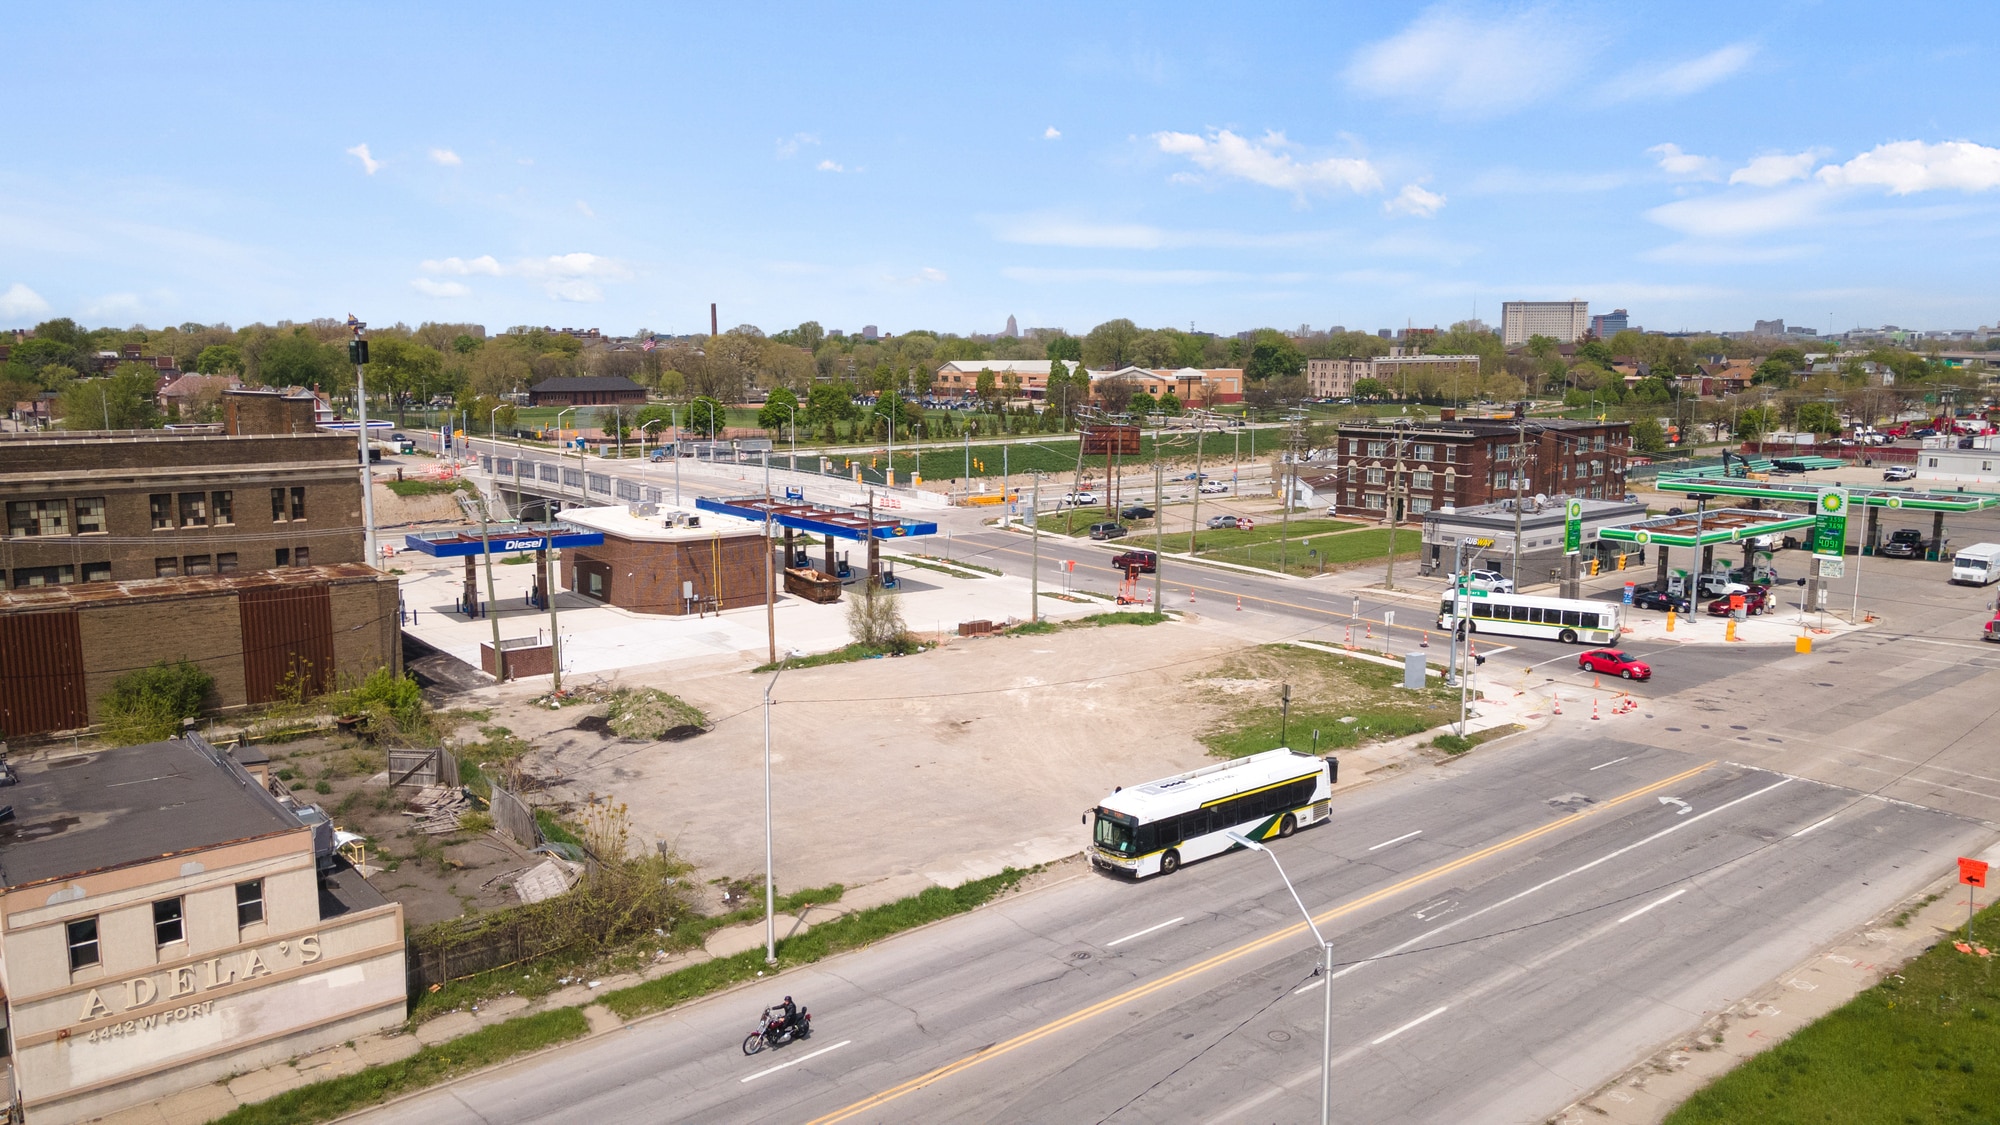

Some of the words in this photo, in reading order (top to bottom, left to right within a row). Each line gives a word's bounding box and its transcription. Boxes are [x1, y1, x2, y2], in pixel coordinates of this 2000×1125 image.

[505, 538, 543, 550] Diesel
[1465, 536, 1495, 547] SUBWAY
[79, 934, 323, 1022] ADELA'S
[88, 1020, 136, 1042] 4442
[140, 1014, 158, 1030] W
[163, 1000, 215, 1024] FORT
